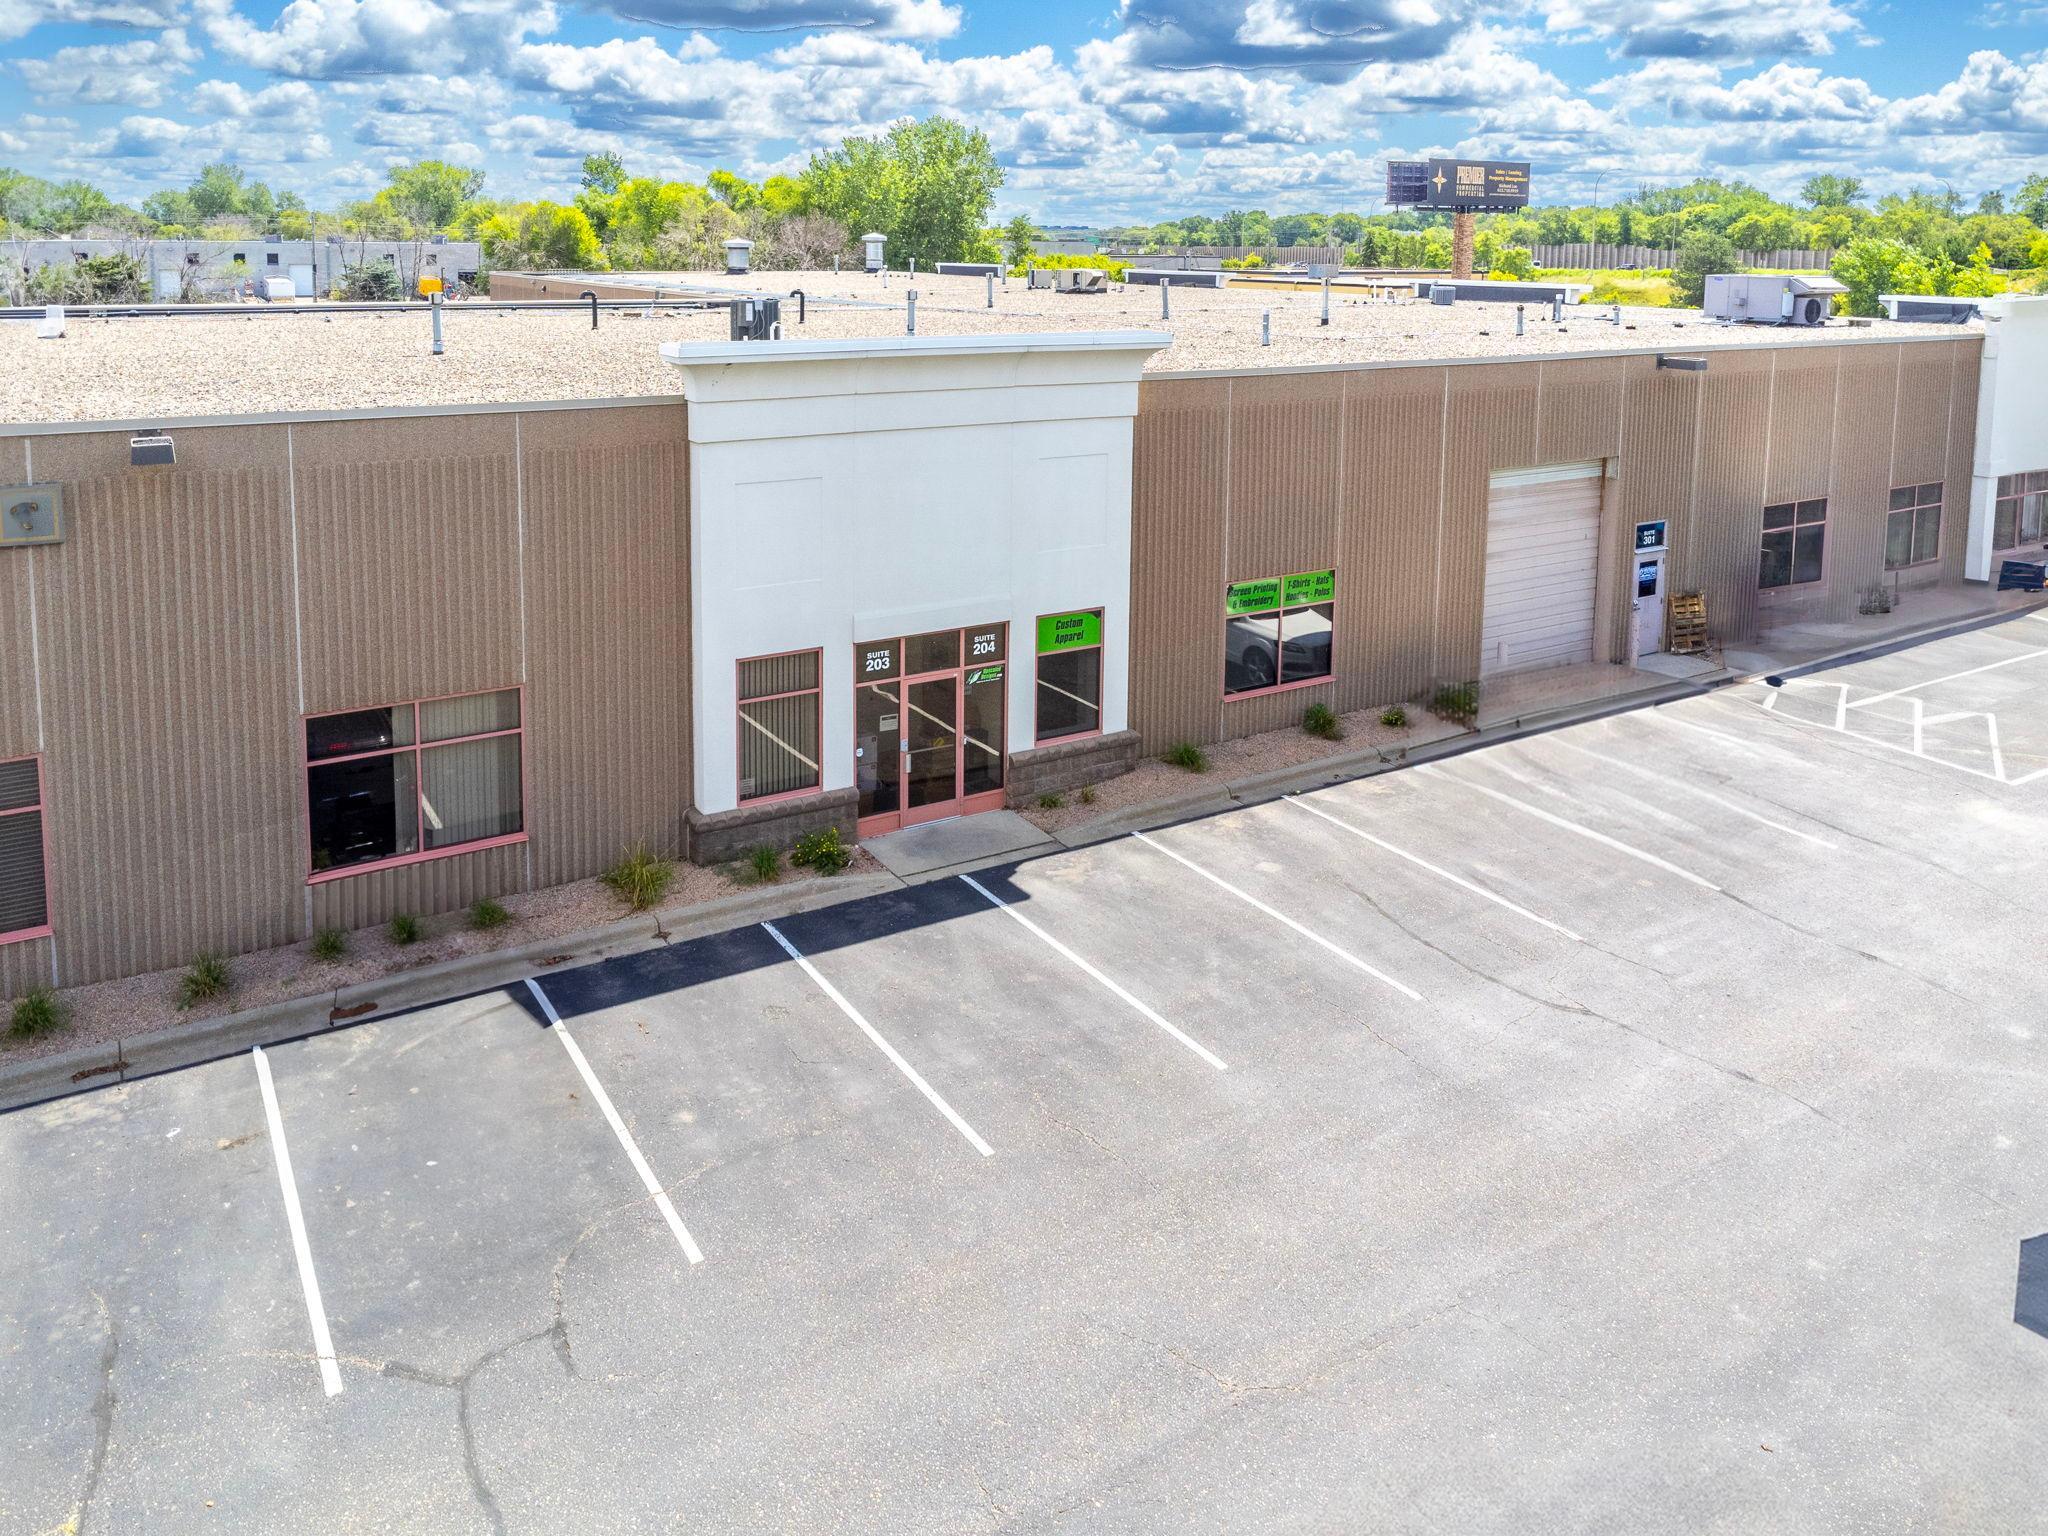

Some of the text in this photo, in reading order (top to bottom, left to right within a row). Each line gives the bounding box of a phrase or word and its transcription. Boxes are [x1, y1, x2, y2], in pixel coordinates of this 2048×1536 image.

[1456, 166, 1485, 184] PREMIER
[1643, 535, 1655, 545] 301
[1253, 583, 1278, 594] Printing
[1287, 578, 1311, 590] T-Shirts
[1316, 576, 1329, 585] Hats
[1314, 588, 1330, 597] Polos
[1239, 596, 1274, 608] Embroidery
[1056, 618, 1083, 631] Custom
[974, 634, 996, 643] SUITE
[1055, 630, 1084, 644] Apparel
[973, 641, 996, 655] 204
[866, 650, 890, 660] SUITE
[866, 658, 890, 672] 203
